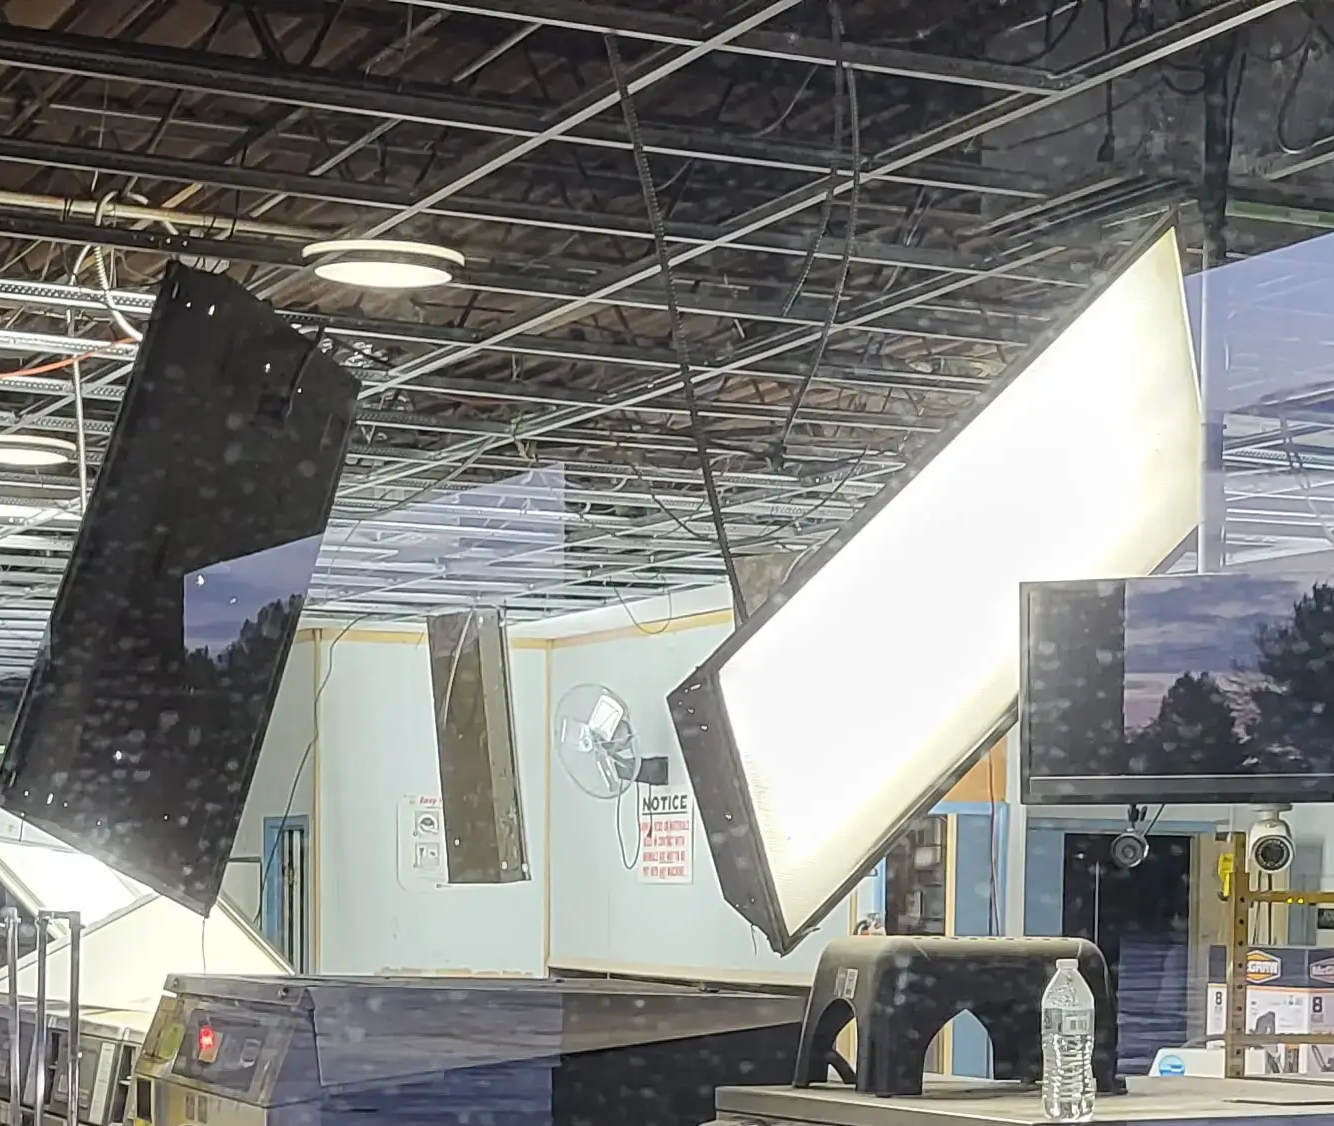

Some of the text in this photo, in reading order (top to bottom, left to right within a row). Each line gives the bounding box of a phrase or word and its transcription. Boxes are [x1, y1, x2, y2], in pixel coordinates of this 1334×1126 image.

[643, 795, 688, 811] NOTICE
[1215, 991, 1223, 1005] 8
[1312, 996, 1323, 1013] 8
